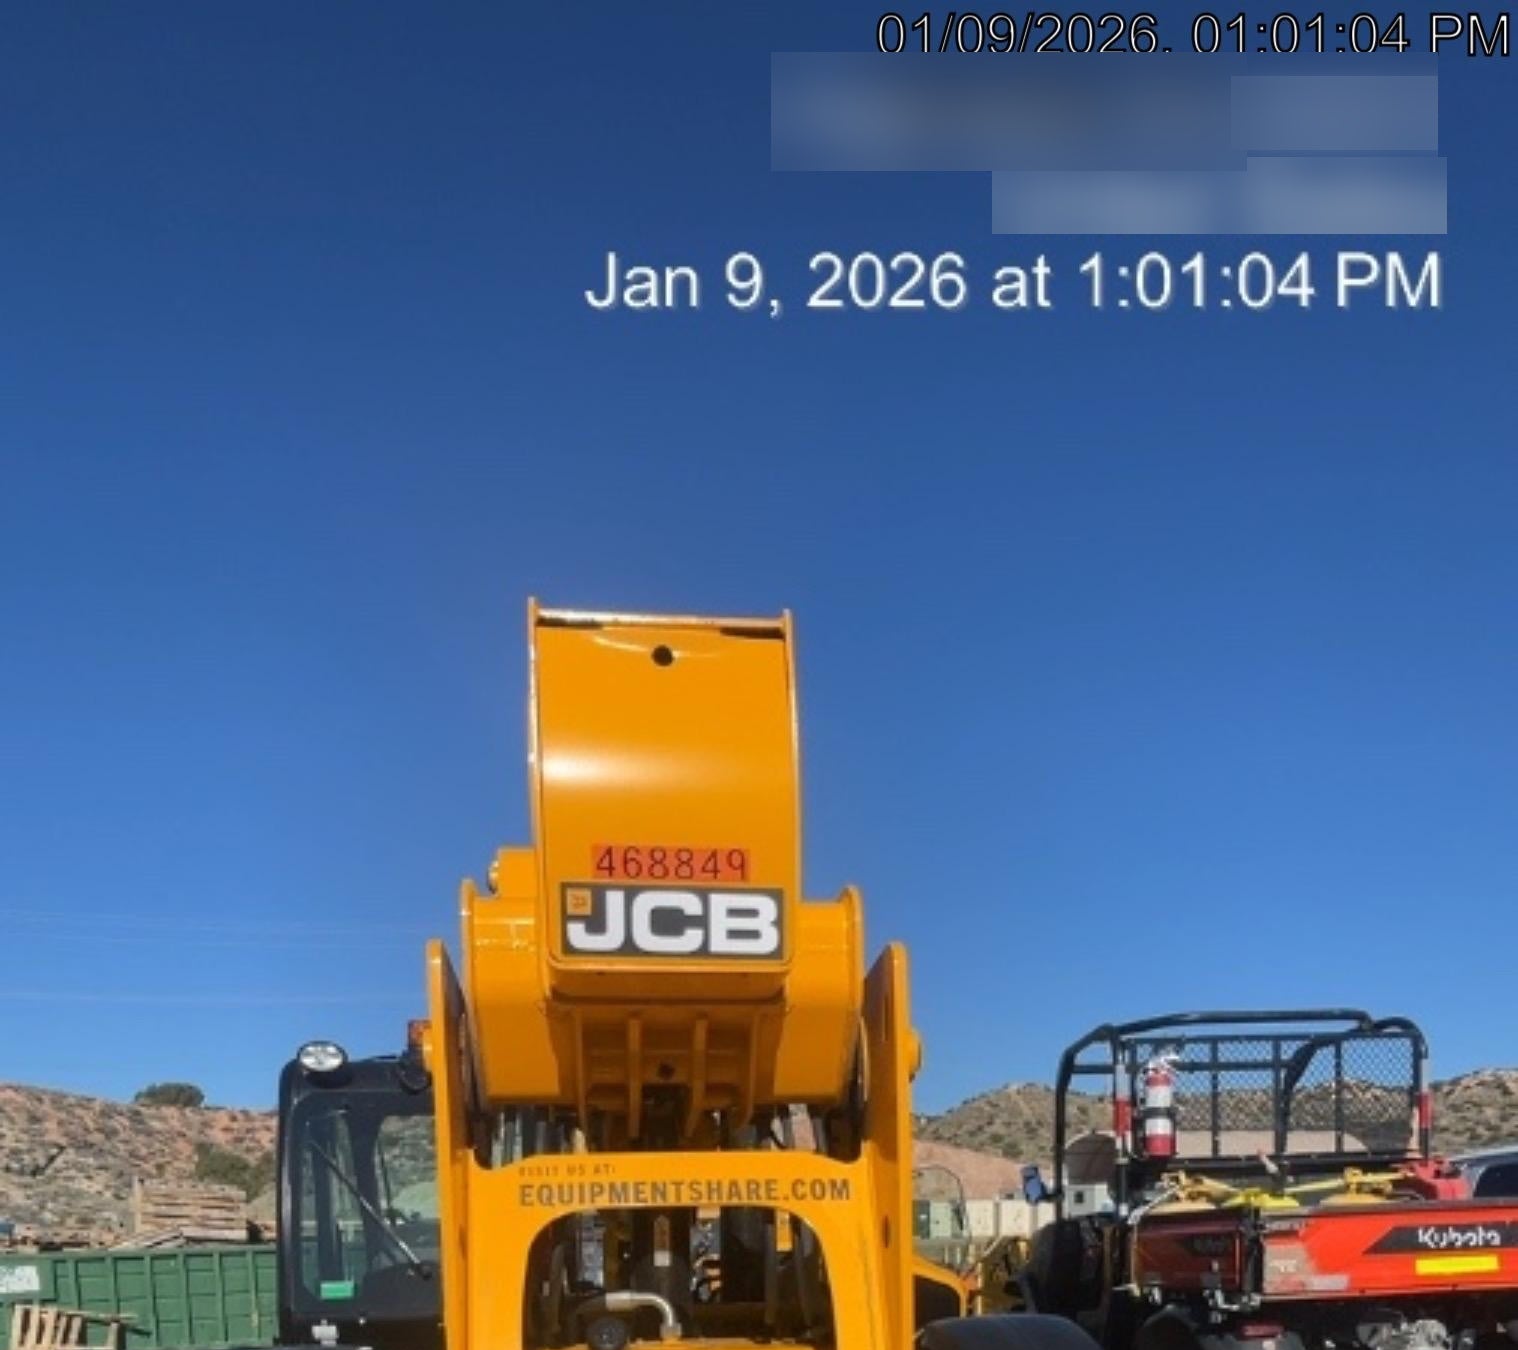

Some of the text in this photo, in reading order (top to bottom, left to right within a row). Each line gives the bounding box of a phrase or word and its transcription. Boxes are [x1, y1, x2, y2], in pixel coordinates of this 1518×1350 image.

[595, 845, 747, 881] 468849
[566, 889, 780, 955] JCB
[518, 1178, 851, 1208] EQUIPMENTSHARE.COM
[1417, 1225, 1502, 1250] Kubota
